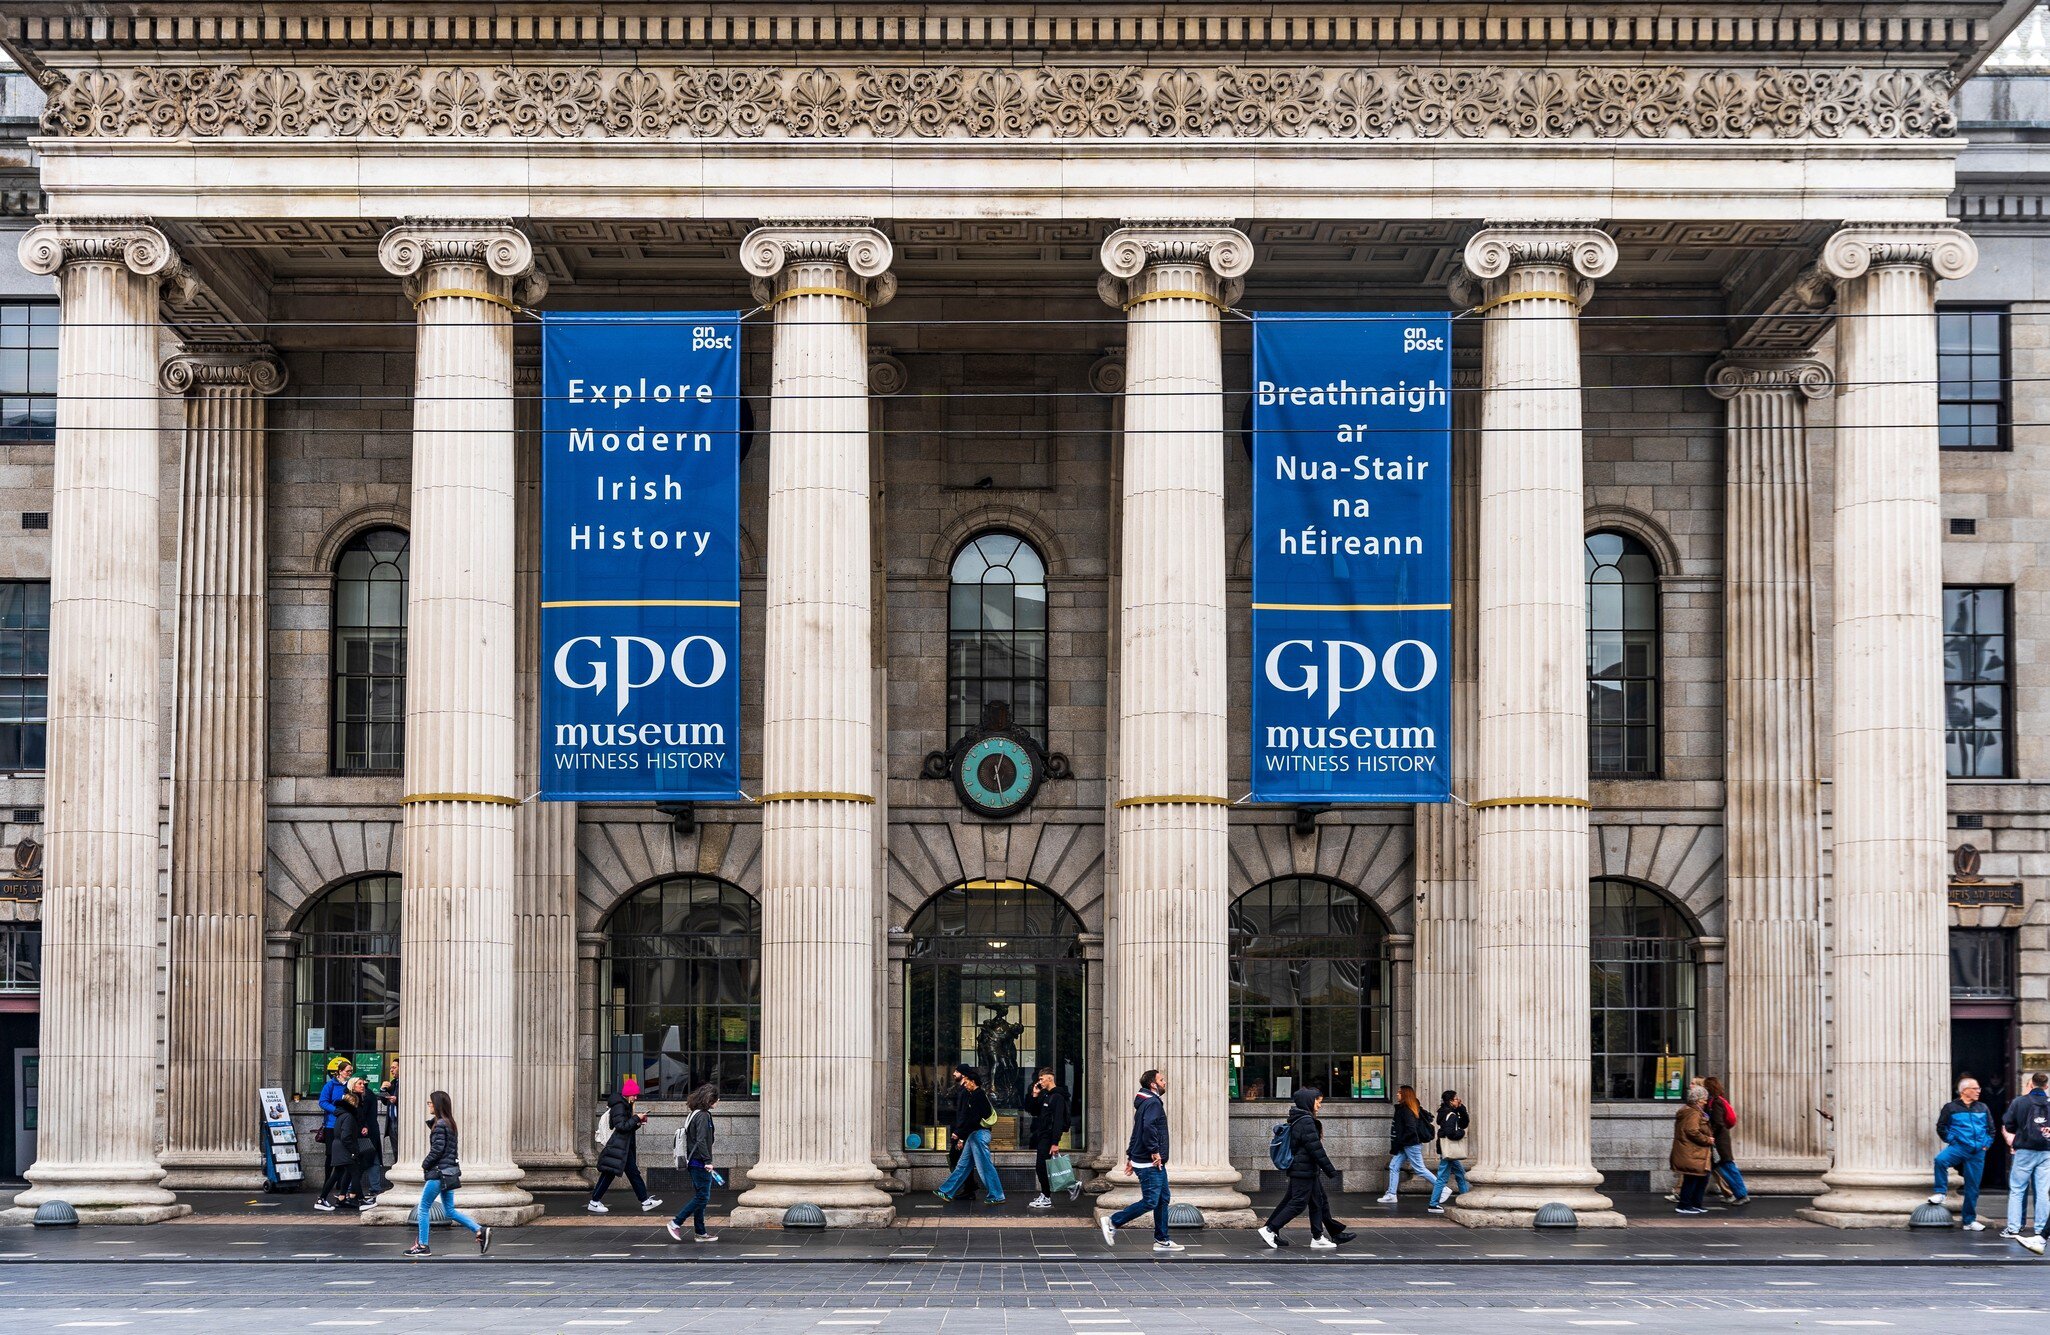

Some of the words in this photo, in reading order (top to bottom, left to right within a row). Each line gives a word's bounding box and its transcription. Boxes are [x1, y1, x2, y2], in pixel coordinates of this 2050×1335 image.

[692, 326, 715, 338] an
[692, 335, 732, 352] post
[1403, 327, 1427, 340] an
[1403, 336, 1444, 354] post
[568, 377, 714, 410] Explore
[1258, 380, 1446, 412] Breathnaigh
[567, 425, 712, 453] Modern
[1336, 421, 1369, 443] ar
[1275, 455, 1430, 481] Nua-Stair
[597, 474, 683, 501] Irish
[1332, 498, 1370, 518] na
[570, 525, 712, 558] History
[1279, 525, 1424, 556] hÉireann
[553, 635, 727, 717] GPO
[1265, 639, 1438, 720] GPO
[554, 722, 726, 750] museum
[1265, 726, 1437, 752] museum
[554, 752, 640, 771] WITNESS
[646, 752, 726, 771] HISTORY
[1265, 755, 1350, 773] WITNESS
[1357, 755, 1436, 773] HISTORY
